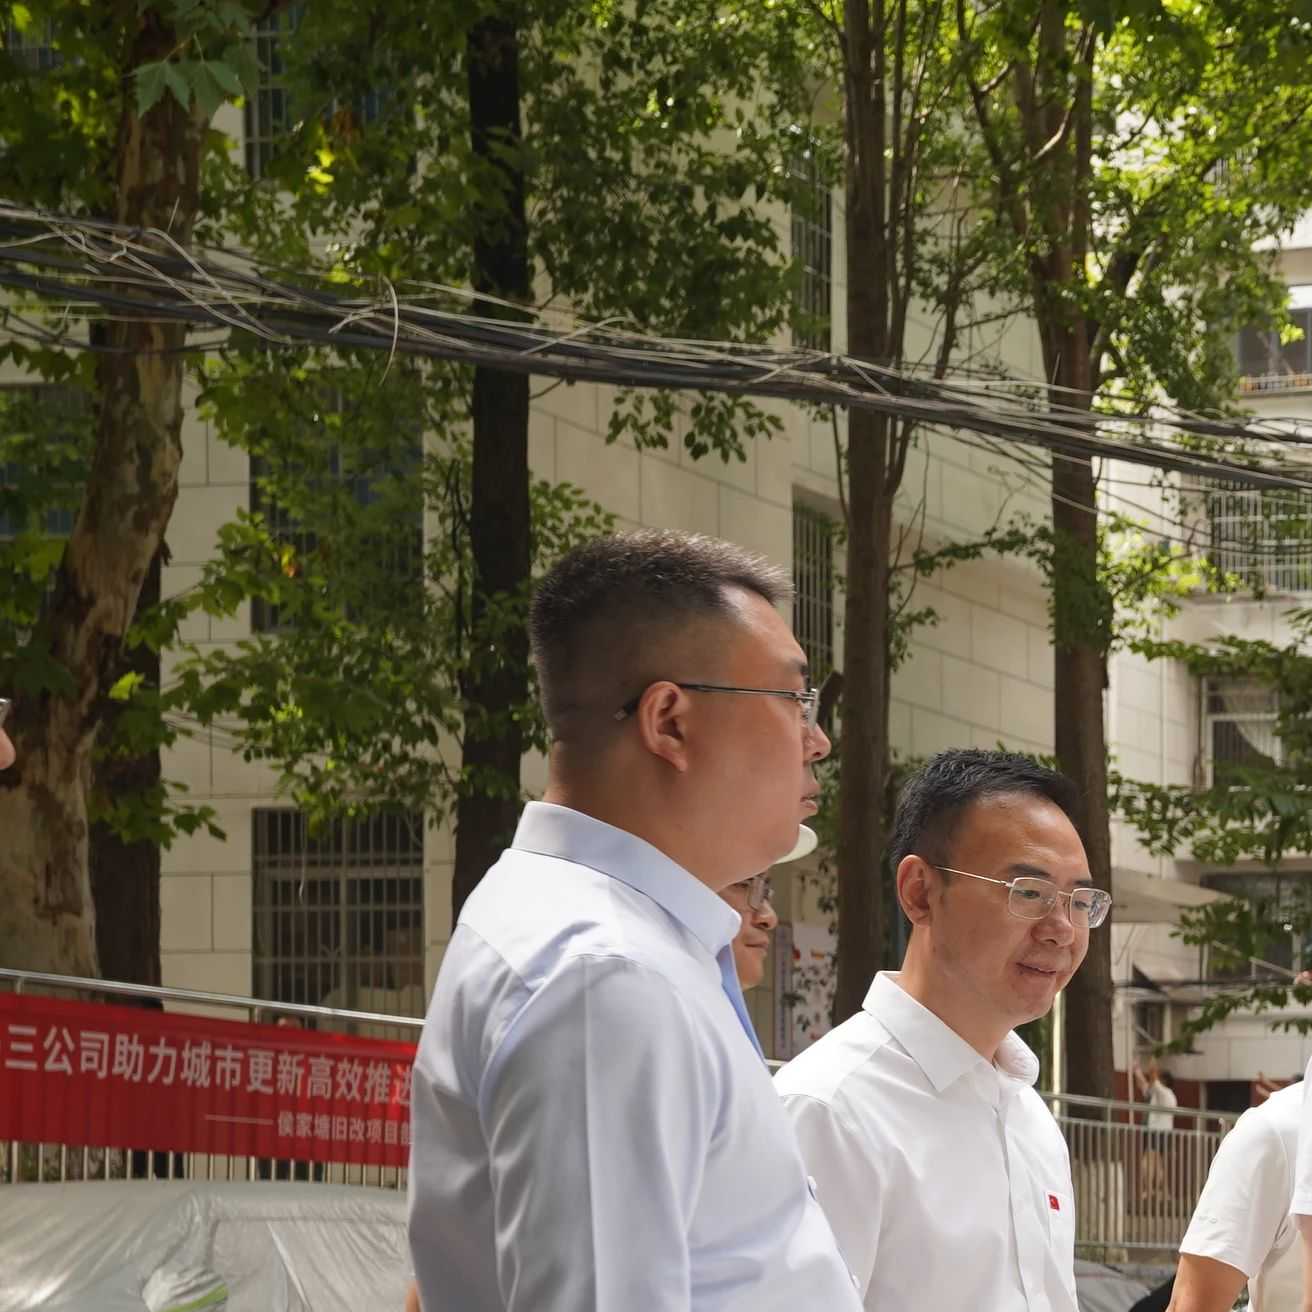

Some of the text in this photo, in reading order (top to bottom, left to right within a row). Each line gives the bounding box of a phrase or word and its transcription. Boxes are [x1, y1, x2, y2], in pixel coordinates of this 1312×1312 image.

[5, 1024, 411, 1105] 三公司助力城市更新高效推进
